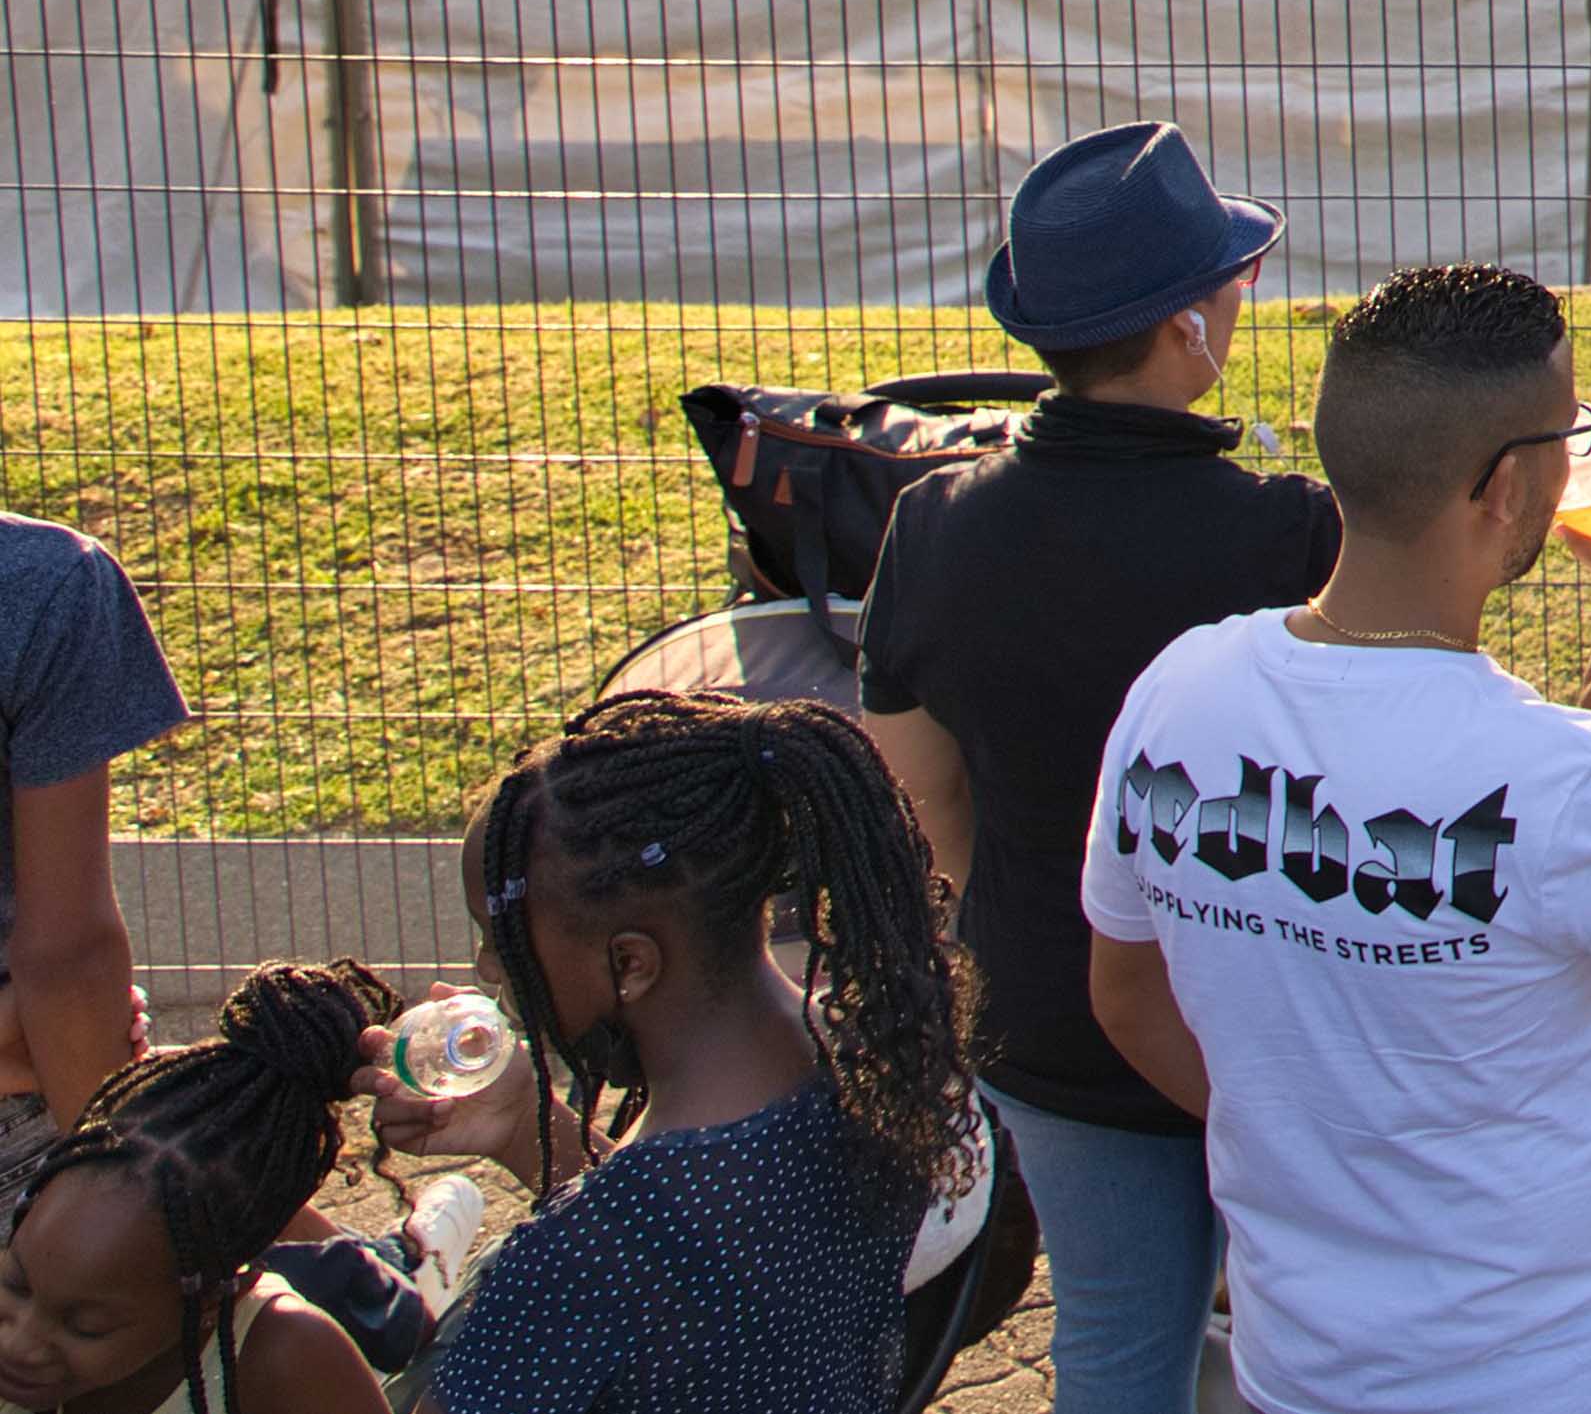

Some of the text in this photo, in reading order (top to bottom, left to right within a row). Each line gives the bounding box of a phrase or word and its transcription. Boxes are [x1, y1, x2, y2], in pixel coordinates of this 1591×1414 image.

[1117, 748, 1517, 925] redbat
[1275, 919, 1326, 953] THE
[1336, 932, 1491, 966] STREETS
